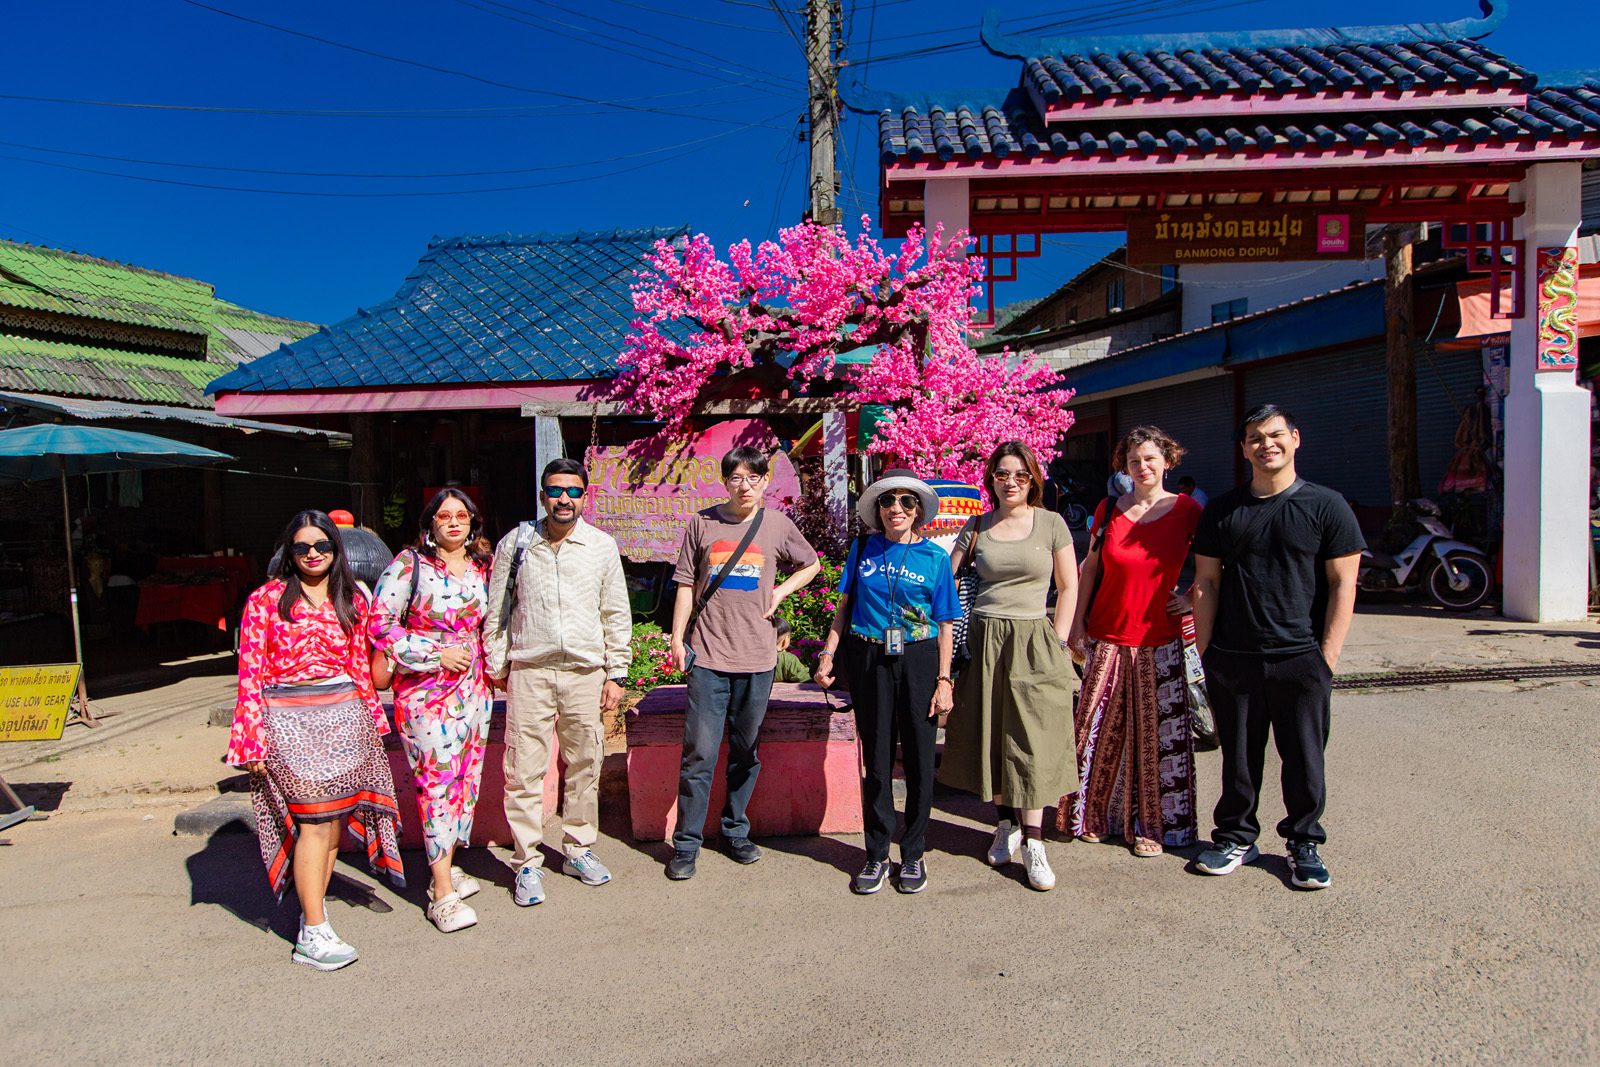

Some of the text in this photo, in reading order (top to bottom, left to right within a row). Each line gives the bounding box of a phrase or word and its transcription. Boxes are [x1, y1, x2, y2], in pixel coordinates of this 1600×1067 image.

[1155, 213, 1302, 246] บ้านม้งดอยปุย
[1175, 248, 1279, 259] BANMONG DOIPUI
[6, 697, 21, 707] USE
[24, 696, 42, 707] LOW
[45, 695, 66, 706] GEAR
[0, 713, 60, 738] งอุปถัมภ์ 1
